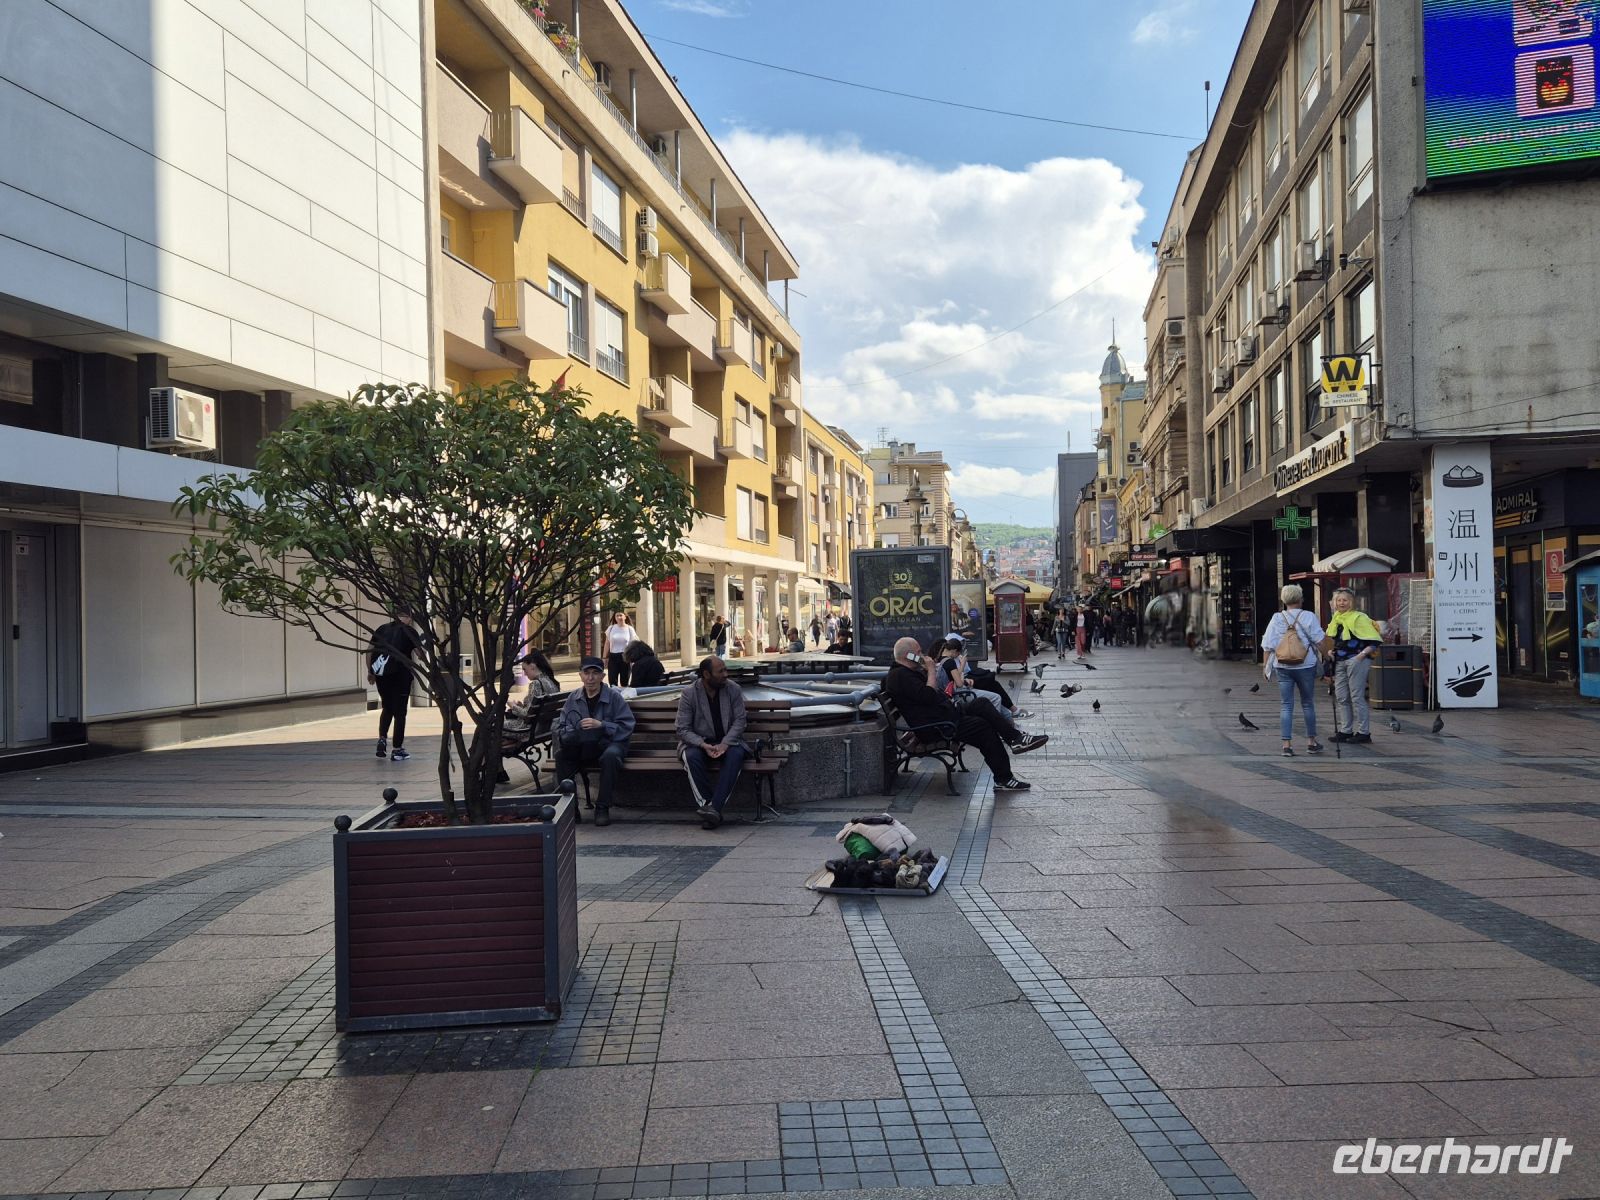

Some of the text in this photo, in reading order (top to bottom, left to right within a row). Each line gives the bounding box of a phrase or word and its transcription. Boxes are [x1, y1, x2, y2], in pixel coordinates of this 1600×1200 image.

[1496, 488, 1538, 514] ADMIRAL
[1448, 509, 1480, 583] 温州
[893, 573, 908, 581] 30
